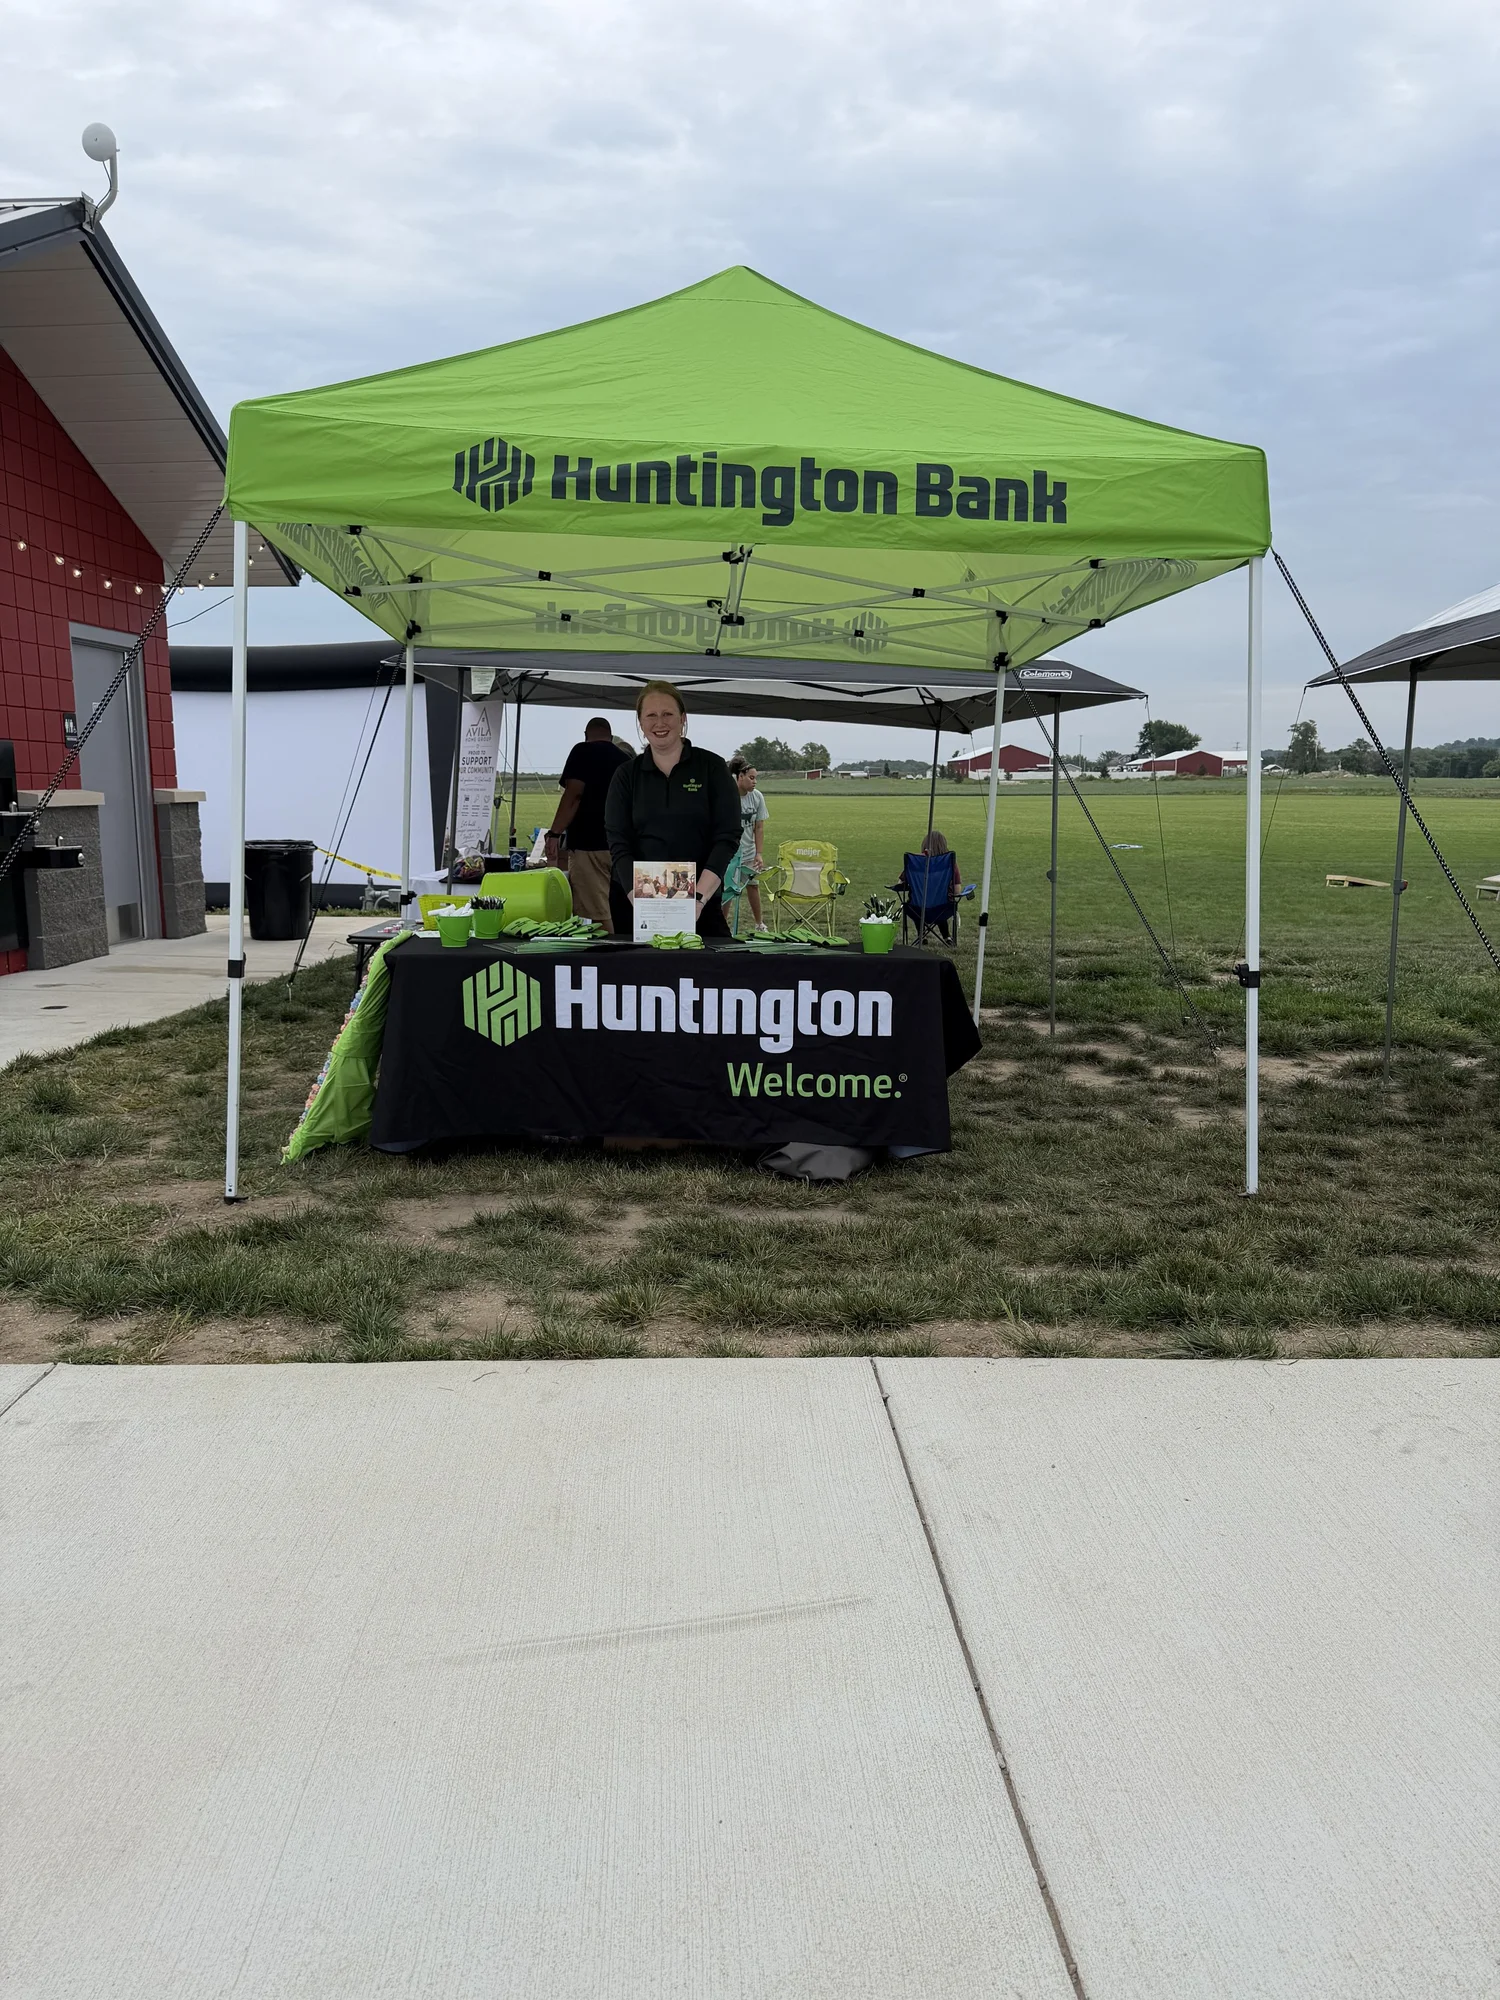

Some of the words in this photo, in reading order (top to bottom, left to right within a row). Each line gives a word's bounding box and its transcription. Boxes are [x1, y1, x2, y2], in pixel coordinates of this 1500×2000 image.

[551, 451, 898, 527] Huntington
[915, 463, 1068, 524] Bank
[1023, 670, 1061, 678] Coleman
[466, 727, 492, 737] AVILA
[461, 756, 492, 766] SUPPORT
[467, 766, 495, 774] COMMUNITY
[796, 847, 821, 857] meijer
[554, 964, 893, 1054] Huntington
